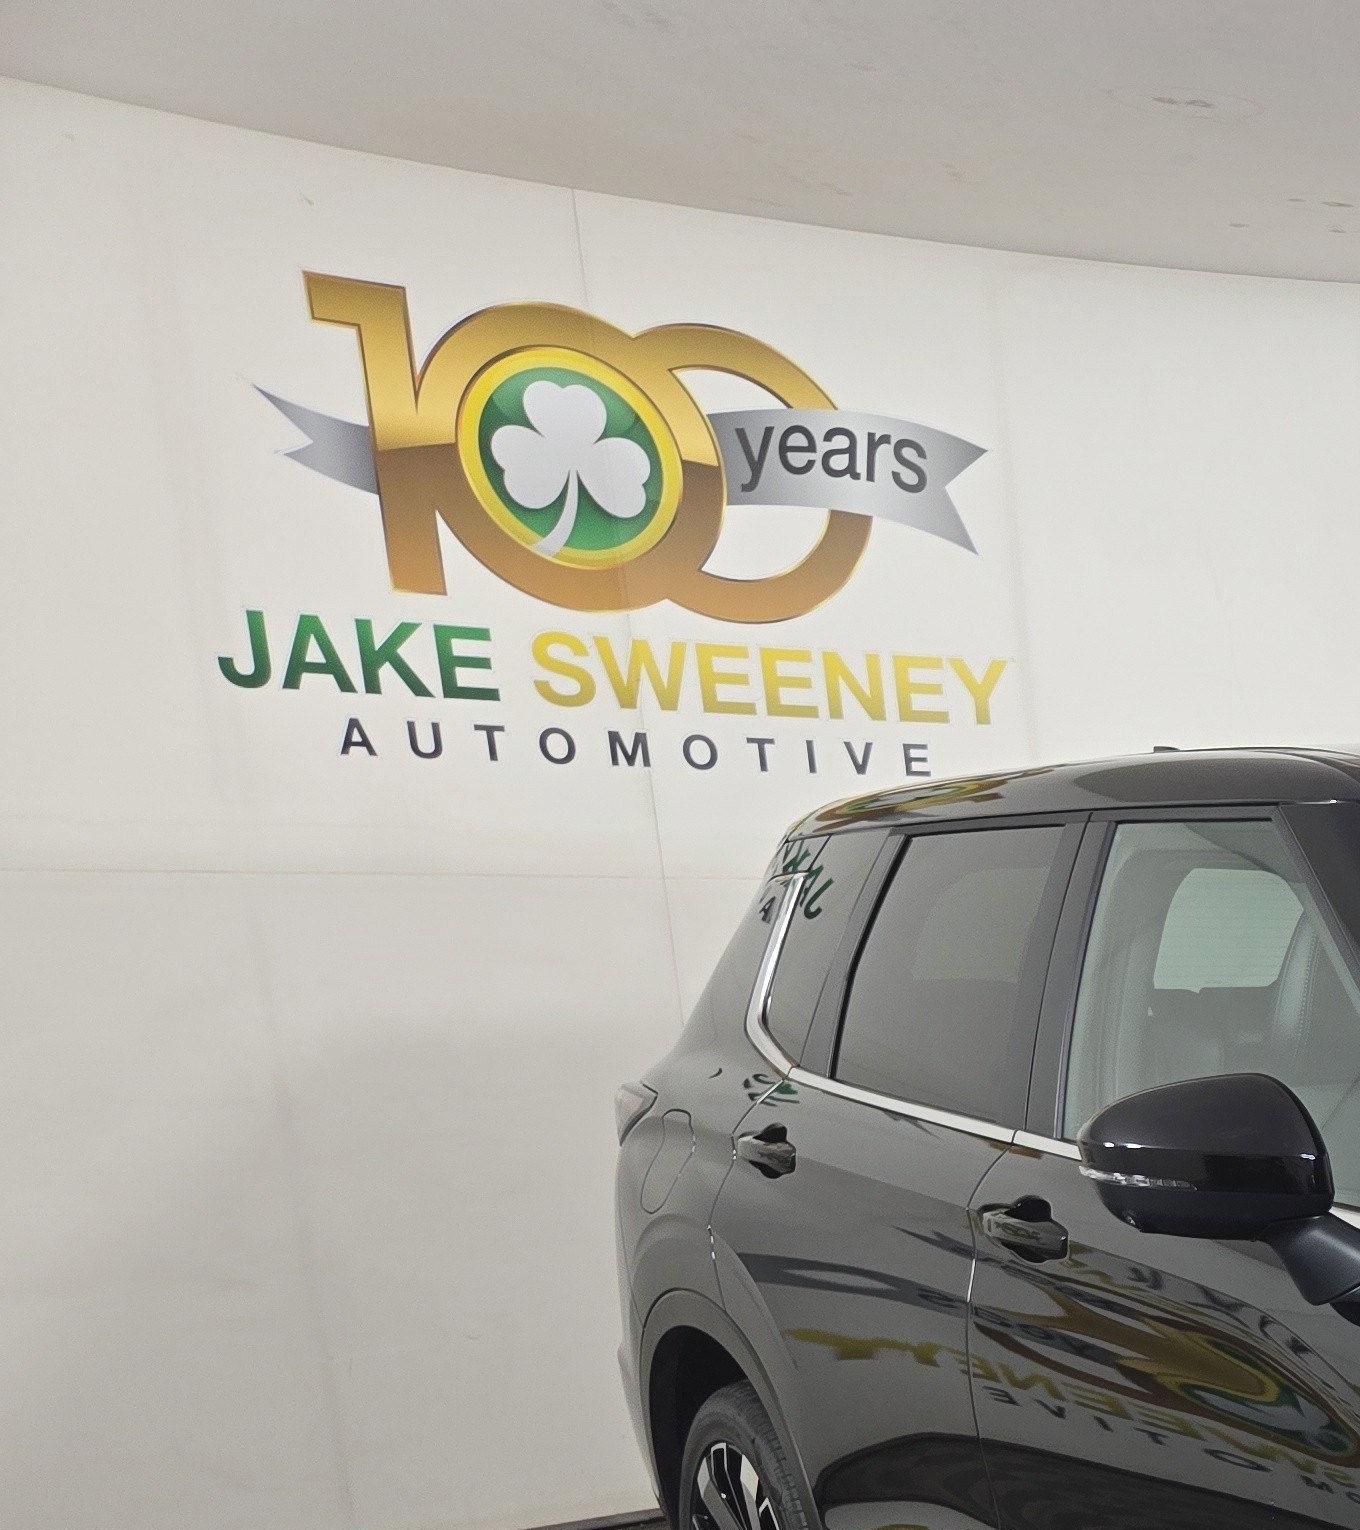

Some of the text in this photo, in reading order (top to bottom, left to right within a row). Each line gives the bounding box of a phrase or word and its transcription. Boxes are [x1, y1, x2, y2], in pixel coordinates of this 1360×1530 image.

[301, 270, 873, 624] 100
[735, 424, 930, 494] years
[218, 609, 1008, 726] JAKE SWEENEY
[341, 717, 932, 777] AUTOMOTIVE
